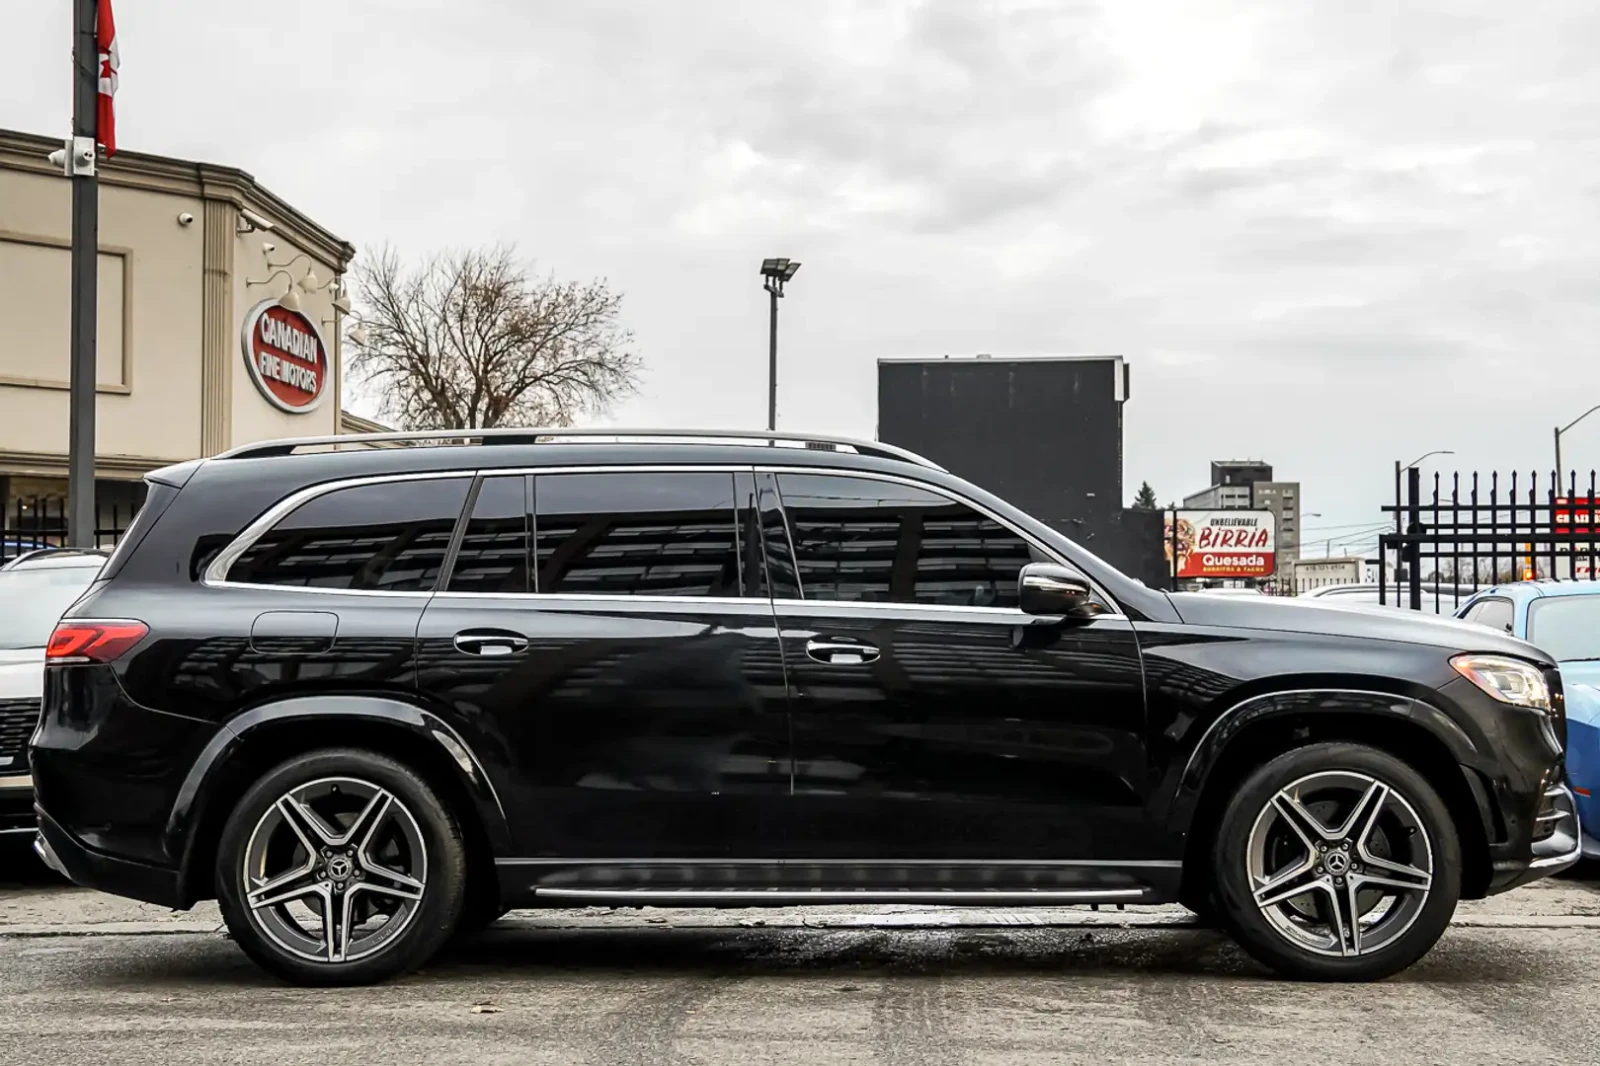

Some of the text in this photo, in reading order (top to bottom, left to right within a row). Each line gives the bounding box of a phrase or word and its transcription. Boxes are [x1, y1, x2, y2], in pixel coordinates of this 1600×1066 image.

[261, 312, 318, 364] CANADIAN
[259, 351, 317, 394] FINE MOTORS
[1210, 517, 1258, 527] UNBELIEVABLE
[1202, 554, 1265, 566] Quesada
